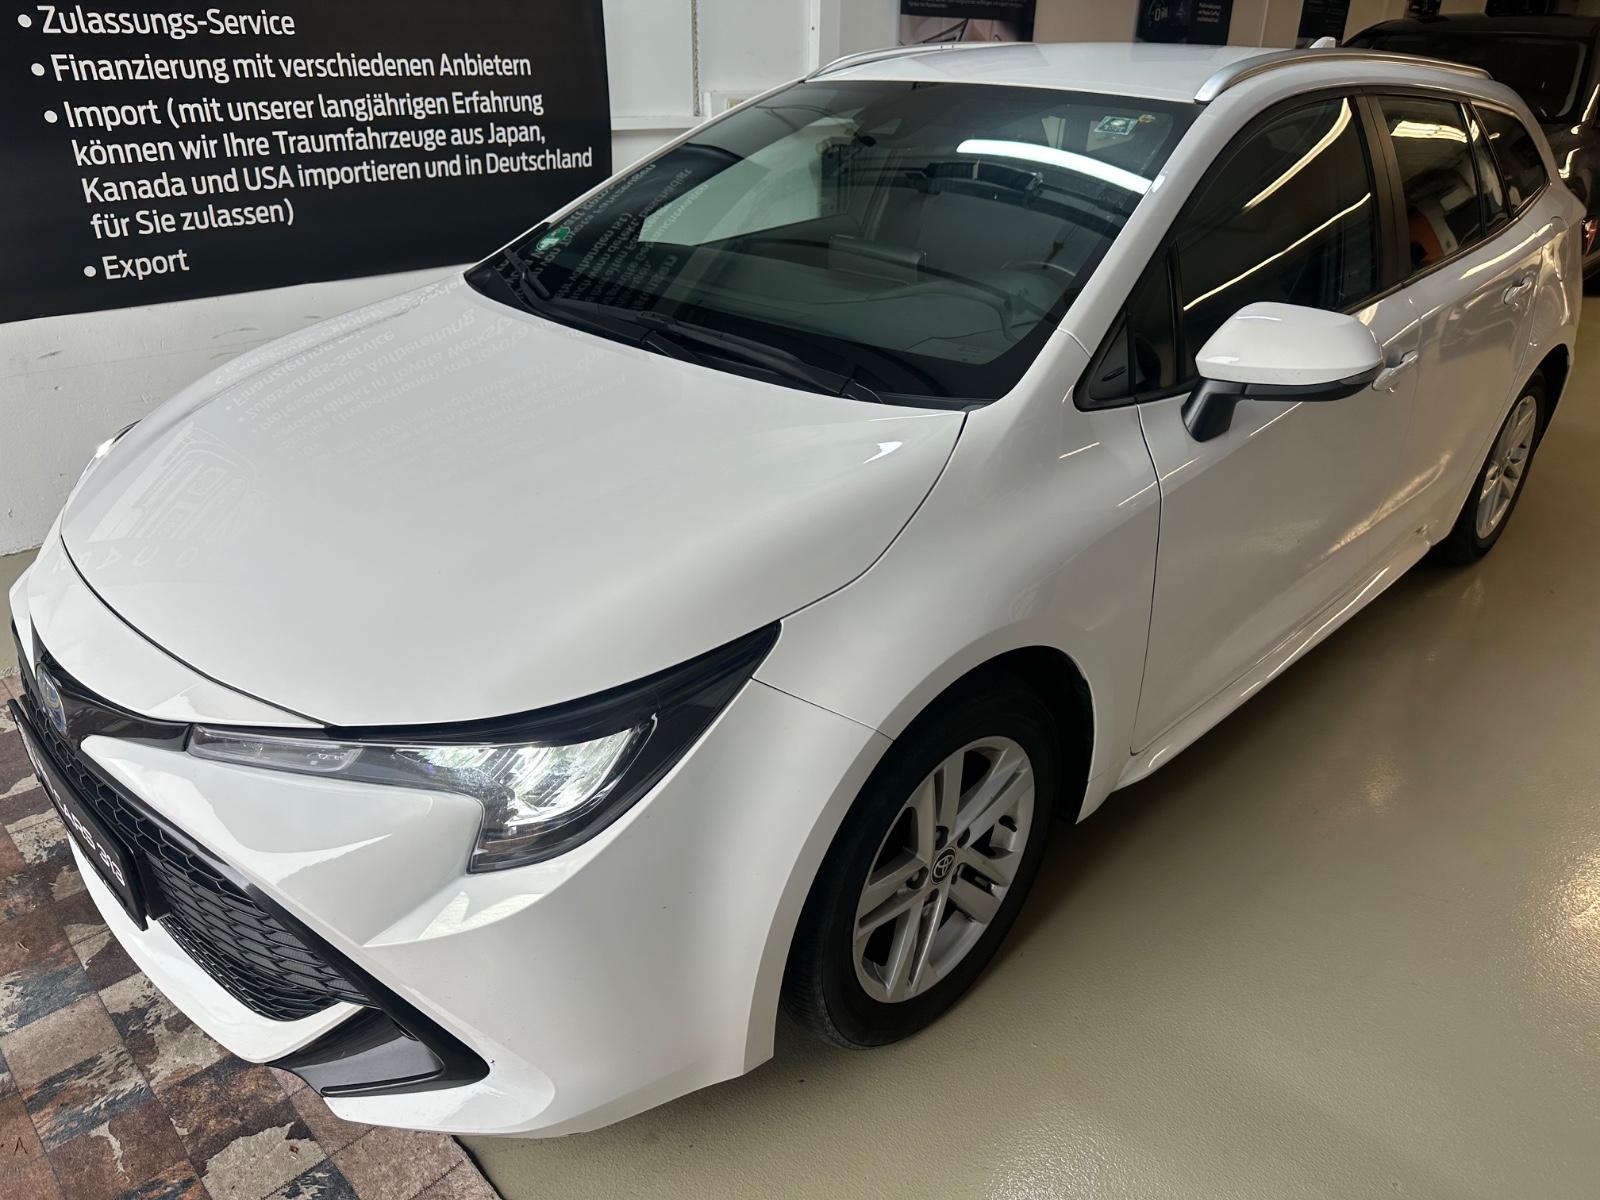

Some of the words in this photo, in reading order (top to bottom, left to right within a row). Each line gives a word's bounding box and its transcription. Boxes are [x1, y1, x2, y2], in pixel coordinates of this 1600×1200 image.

[38, 5, 296, 39] Zulassungs-Service
[51, 54, 229, 83] Finanzierung
[233, 53, 276, 78] mit
[278, 52, 435, 77] verschiedenen
[440, 53, 531, 76] Anbietern
[64, 100, 161, 131] Import
[167, 97, 224, 127] (mit
[227, 100, 314, 121] unserer
[318, 92, 449, 120] langjährigen
[452, 90, 544, 115] Erfahrung
[72, 140, 175, 166] können
[179, 134, 217, 160] wir
[223, 132, 270, 157] Ihre
[272, 127, 446, 154] Traumfahrzeuge
[451, 128, 484, 145] aus
[488, 122, 545, 147] Japan,
[82, 172, 187, 203] Kanada
[191, 168, 239, 194] und
[243, 165, 294, 190] USA
[297, 162, 421, 189] importieren
[425, 154, 461, 178] und
[465, 155, 482, 175] in
[486, 147, 592, 173] Deutschland
[90, 214, 129, 239] für
[136, 210, 176, 234] Sie
[180, 198, 293, 230] zulassen)
[102, 249, 189, 280] Export
